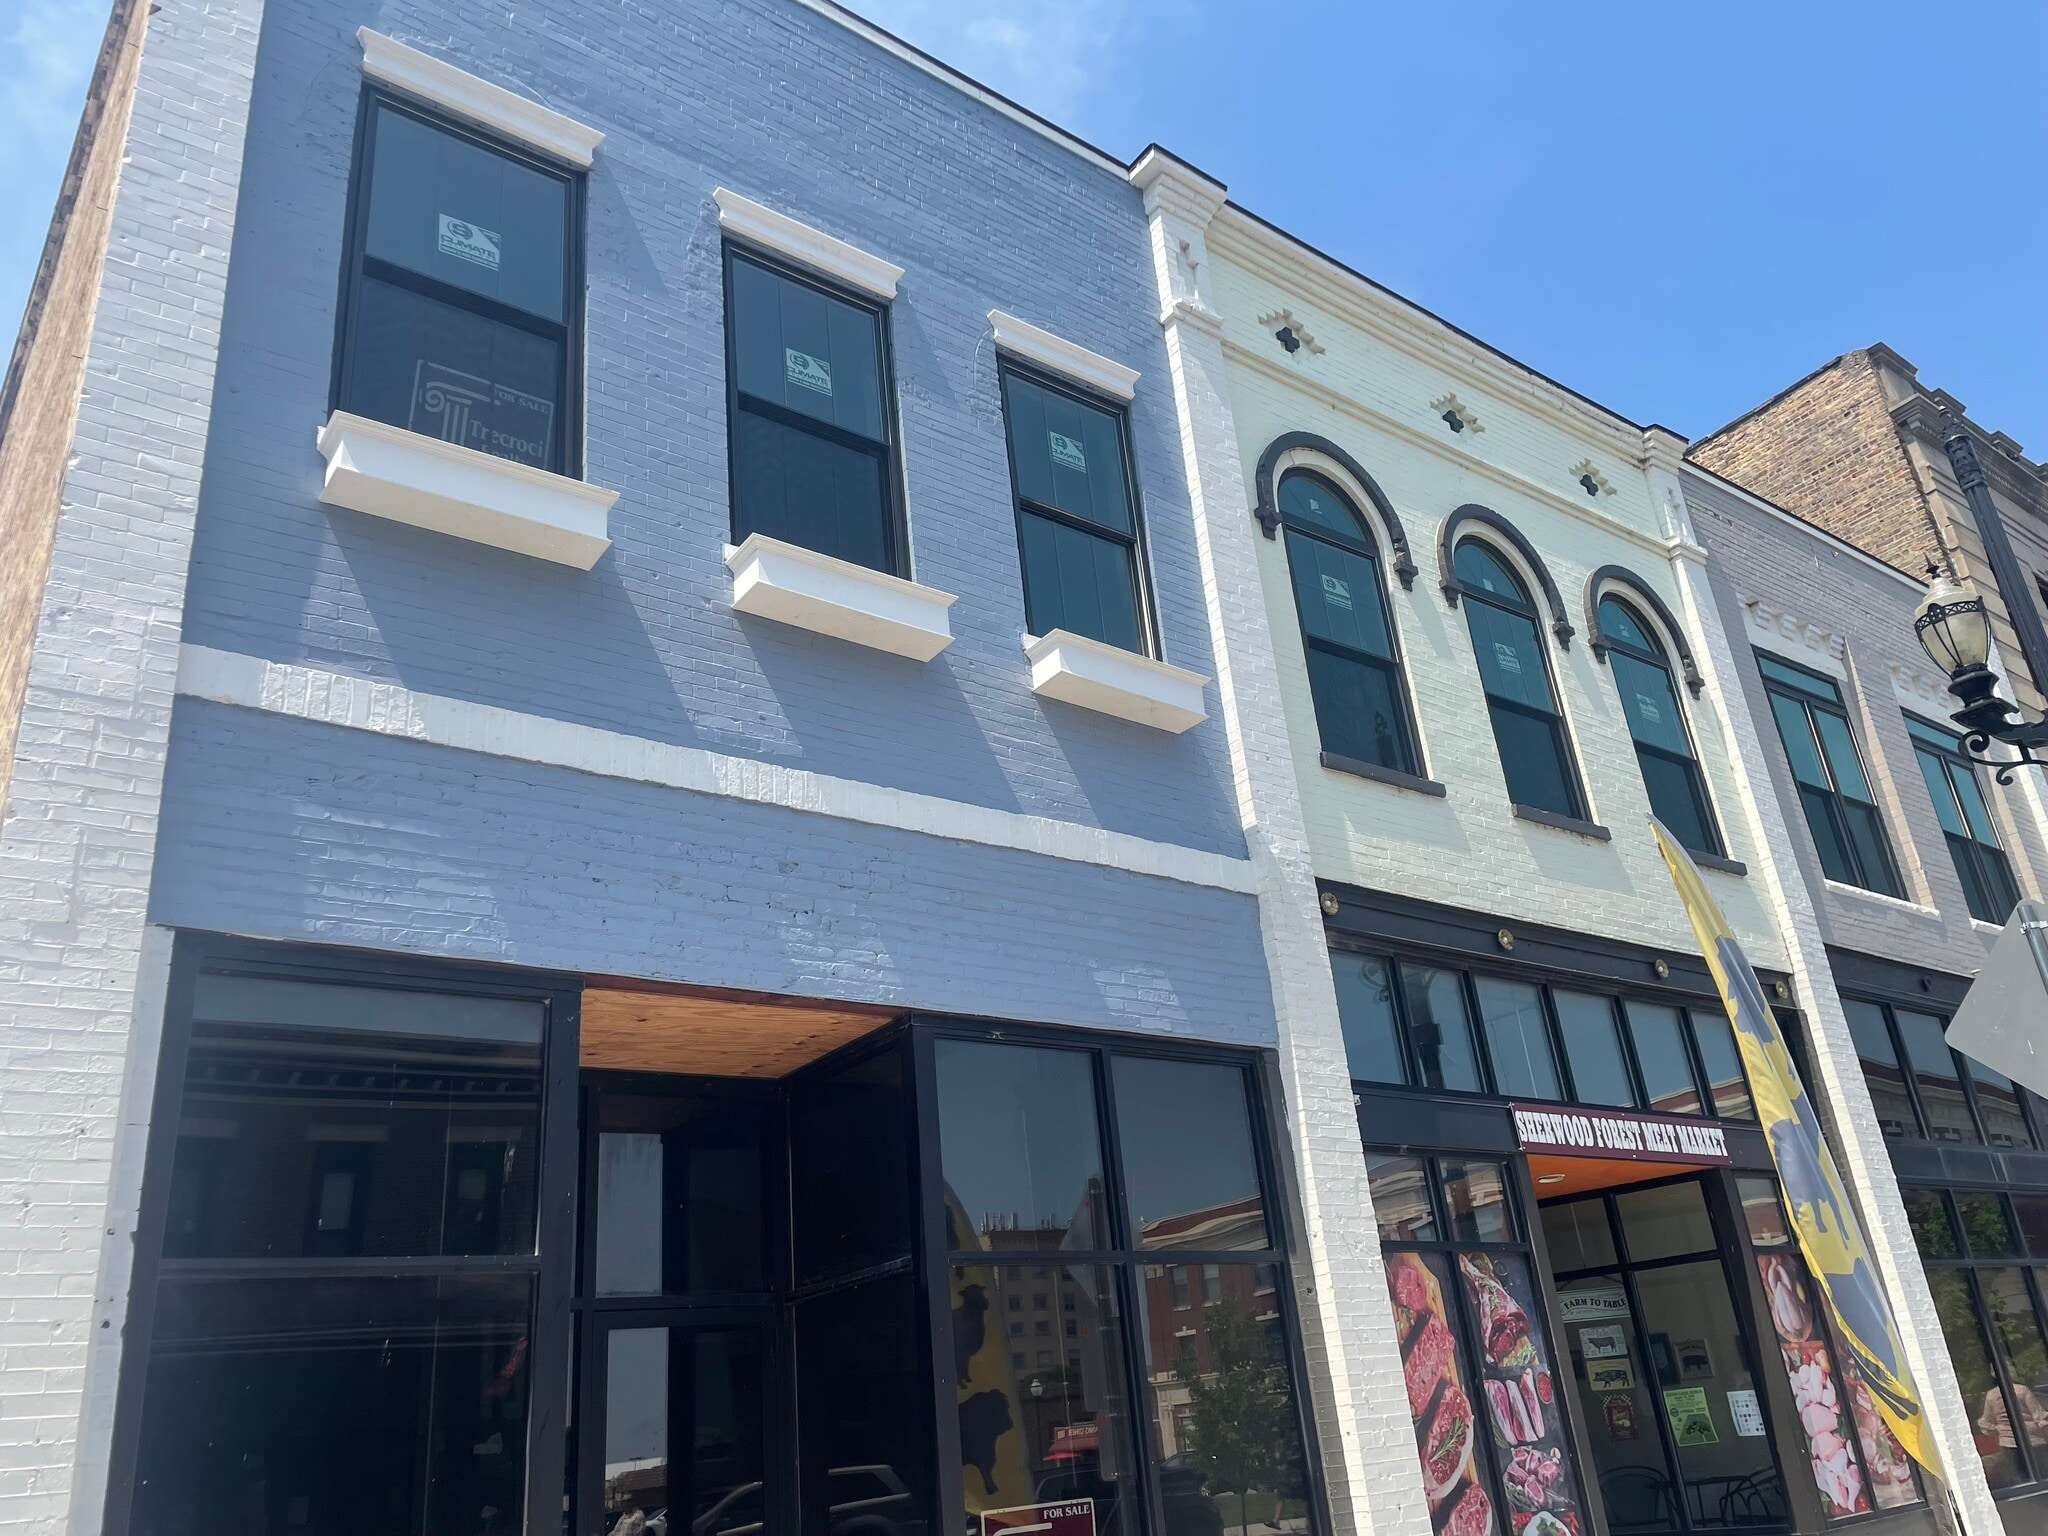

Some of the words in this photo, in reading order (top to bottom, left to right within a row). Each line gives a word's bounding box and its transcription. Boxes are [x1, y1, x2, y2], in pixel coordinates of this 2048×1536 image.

[494, 389, 516, 404] OR
[519, 397, 549, 414] SALE
[470, 419, 544, 458] Trecroci
[1514, 1110, 1594, 1148] SHERWOOD
[1592, 1117, 1644, 1151] FOREST
[1640, 1121, 1679, 1153] MEAT
[1675, 1125, 1729, 1157] MARKET
[1563, 1298, 1588, 1310] FARM
[1589, 1298, 1601, 1307] TO
[1603, 1297, 1627, 1309] TABLE
[1043, 1508, 1064, 1520] FOR
[1065, 1504, 1091, 1517] SALE
